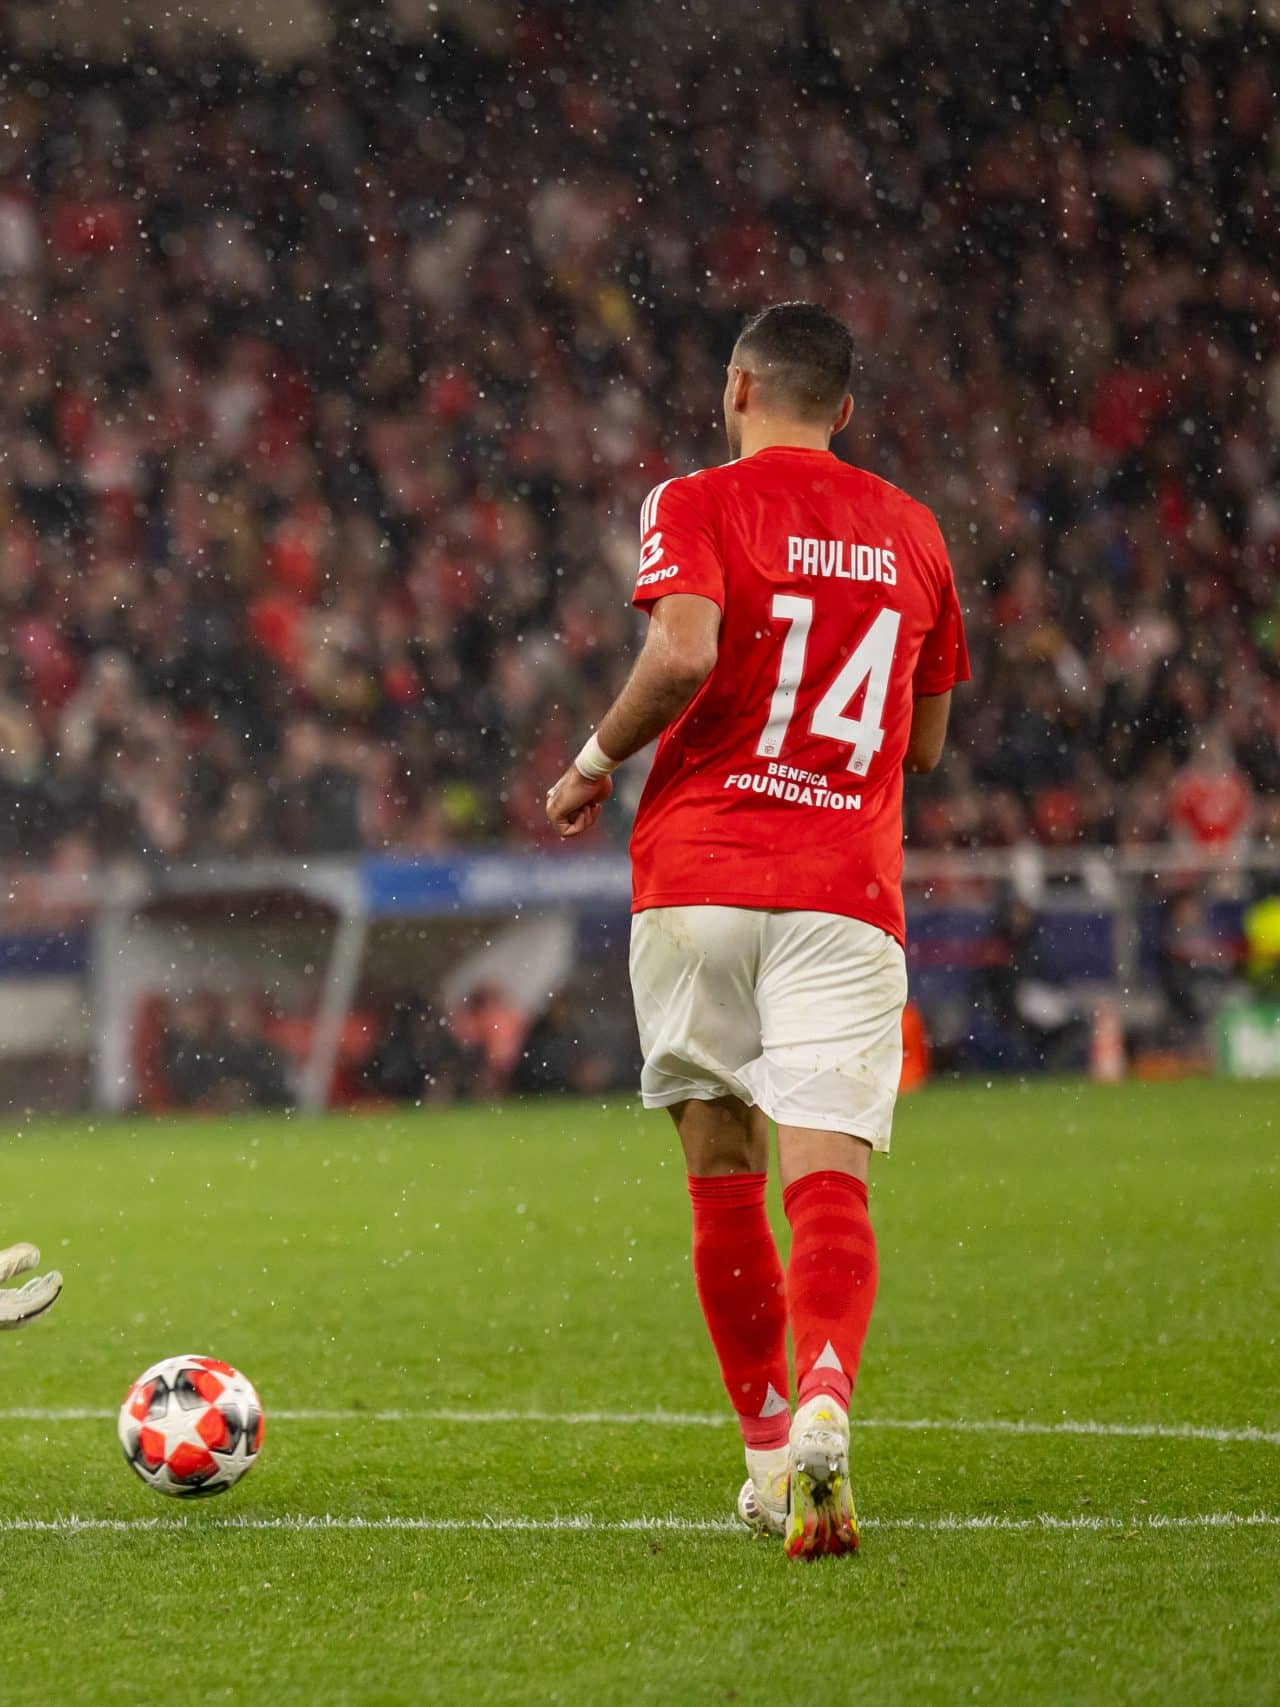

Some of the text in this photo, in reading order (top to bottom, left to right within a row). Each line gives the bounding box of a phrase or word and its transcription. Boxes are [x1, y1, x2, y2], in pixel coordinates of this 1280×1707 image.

[788, 535, 897, 586] PAVLIDIS
[756, 593, 902, 777] 14
[723, 773, 862, 810] FOUNDATION
[767, 762, 829, 787] BENFICA
